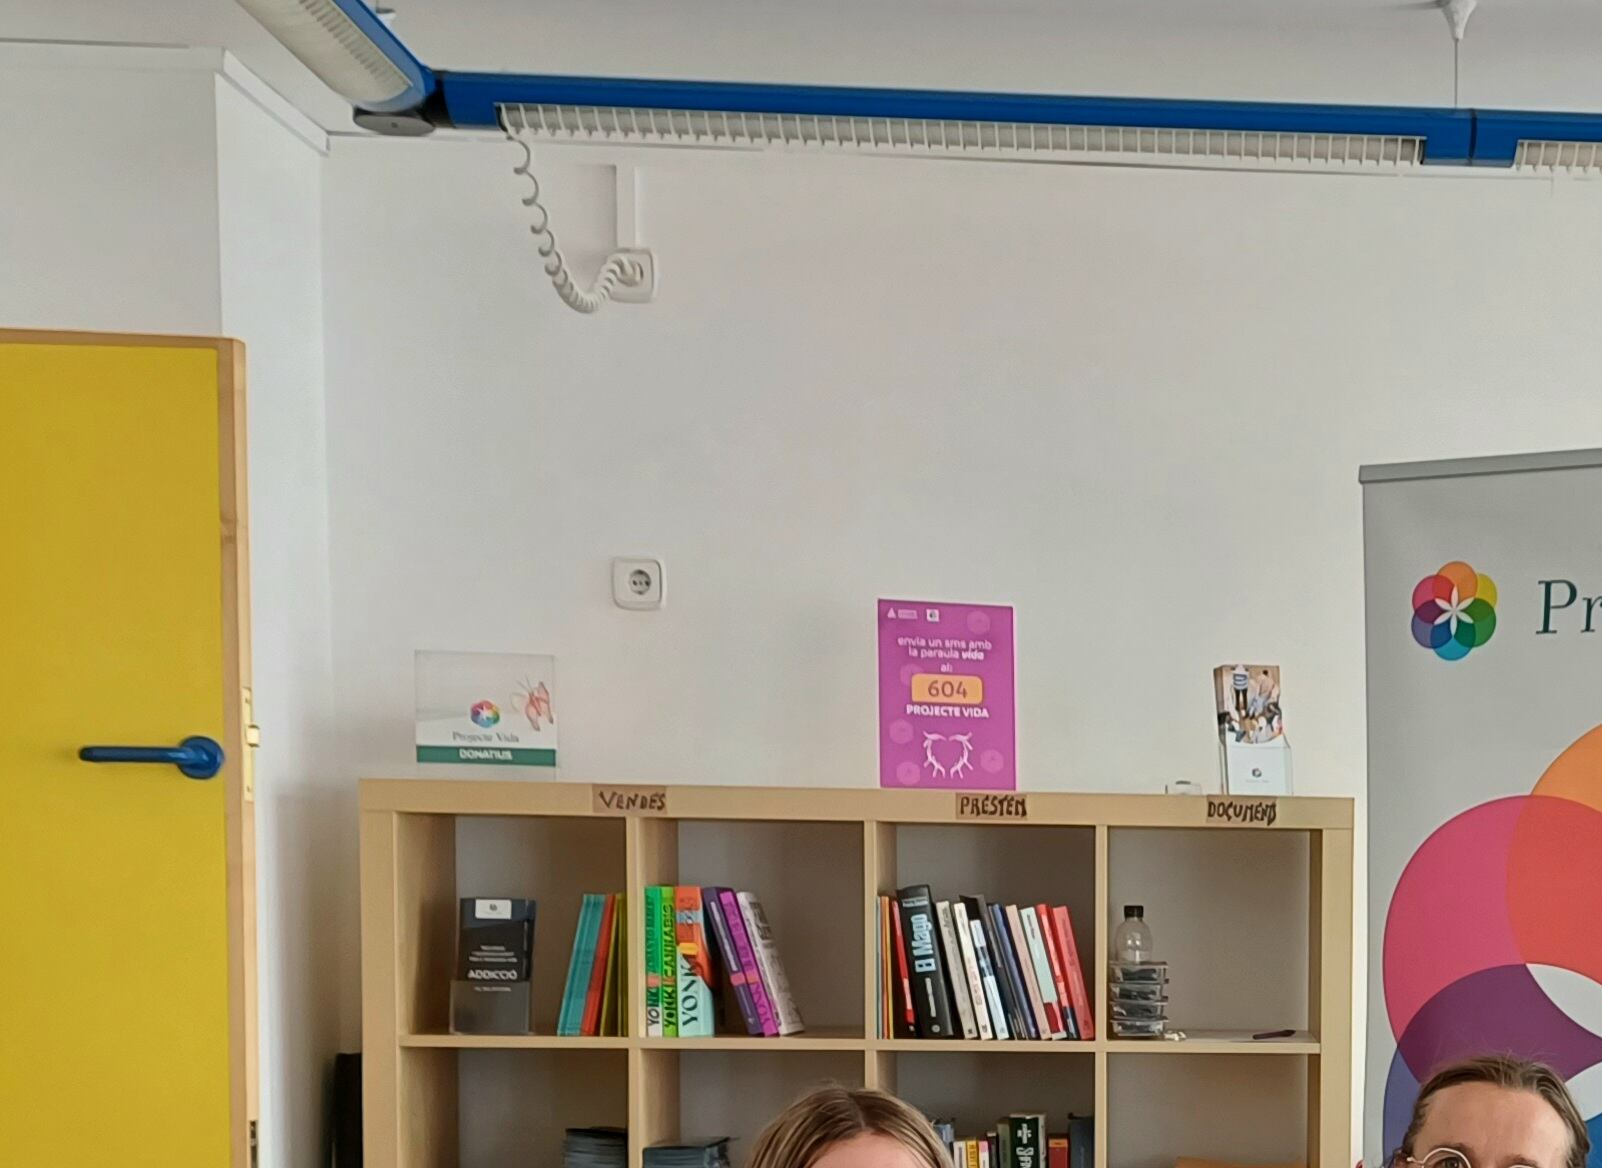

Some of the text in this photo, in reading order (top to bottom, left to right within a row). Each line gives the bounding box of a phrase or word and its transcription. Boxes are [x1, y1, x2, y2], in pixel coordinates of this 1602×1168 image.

[927, 679, 968, 699] 604
[906, 704, 990, 719] PROJECTE VIDA
[598, 790, 666, 811] VENDES
